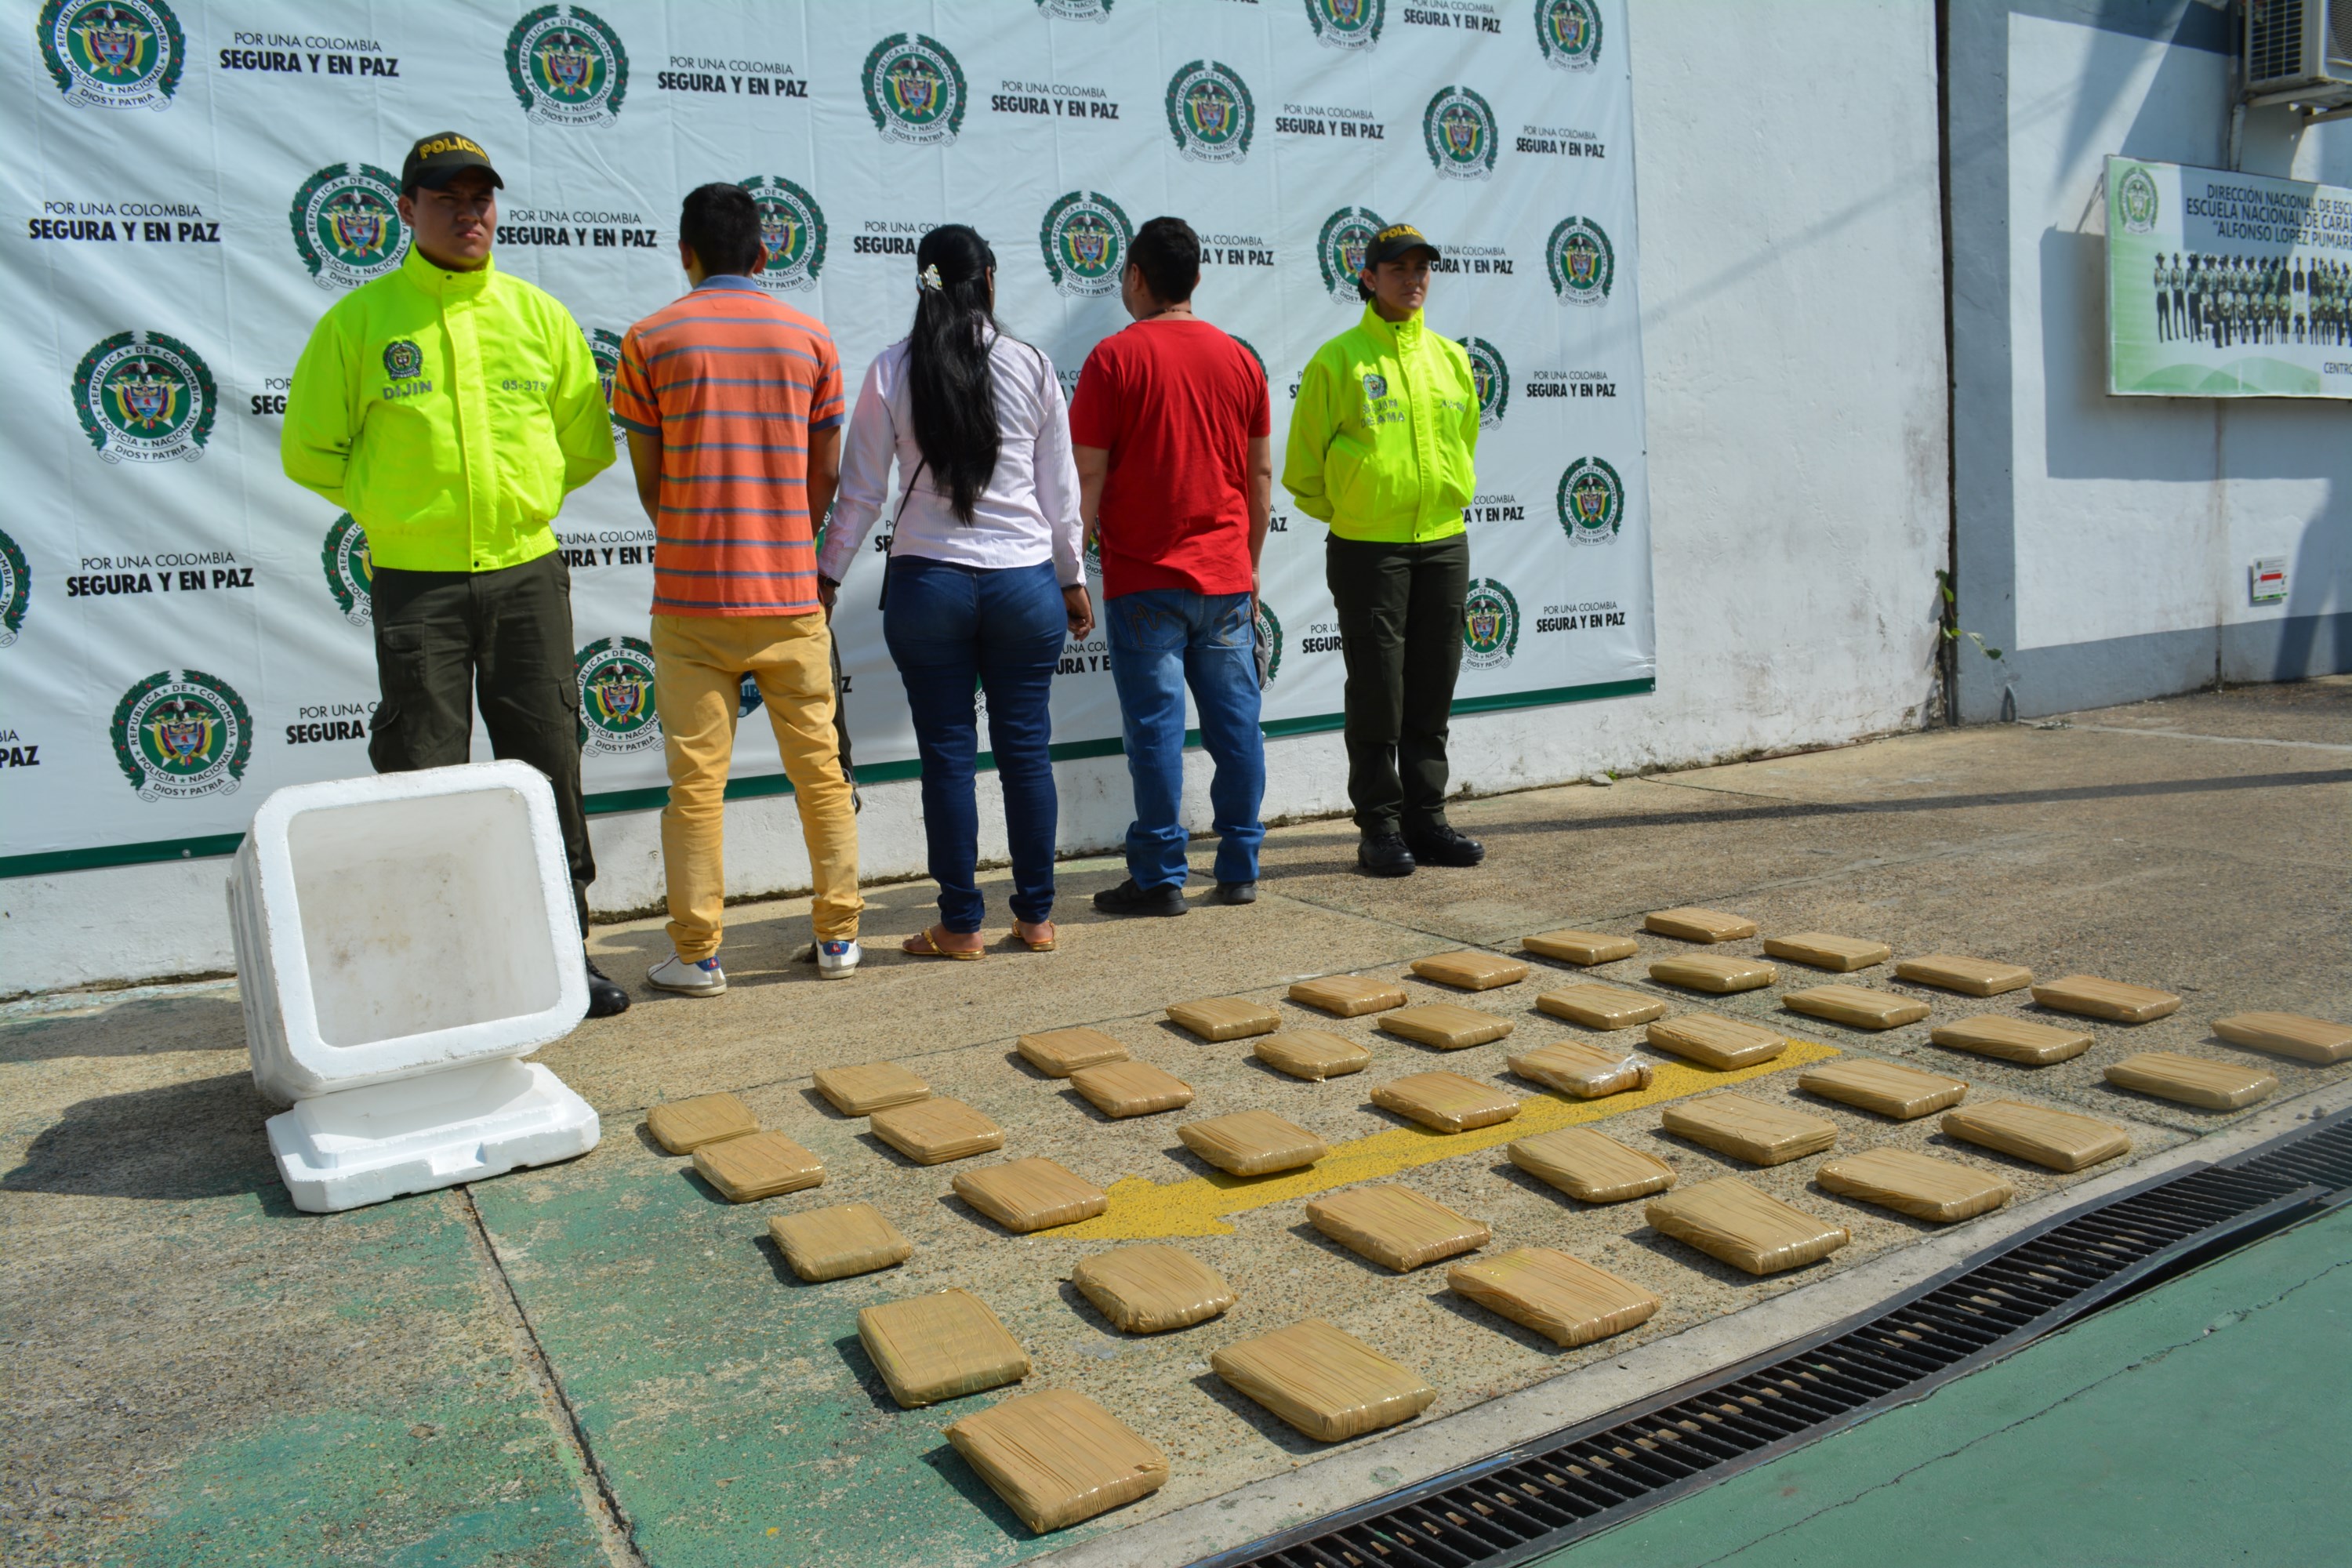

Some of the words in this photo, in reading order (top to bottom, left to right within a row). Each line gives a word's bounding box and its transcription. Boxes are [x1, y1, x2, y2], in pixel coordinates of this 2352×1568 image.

[1450, 1, 1495, 15] COLOMBIA
[1404, 8, 1450, 27] SEGURA
[1453, 13, 1461, 27] Y
[1465, 15, 1479, 30] EN
[1482, 16, 1501, 34] PAZ
[234, 32, 263, 45] POR
[267, 34, 302, 48] UNA
[305, 36, 382, 53] COLOMBIA
[583, 26, 615, 75] COLOMBIA
[220, 49, 302, 72] SEGURA
[307, 53, 321, 73] Y
[327, 55, 353, 74] EN
[359, 56, 399, 77] PAZ
[670, 56, 695, 68] POR
[698, 58, 727, 71] UNA
[729, 60, 793, 74] COLOMBIA
[658, 71, 727, 93] SEGURA
[731, 76, 742, 93] Y
[748, 77, 769, 96] EN
[775, 78, 808, 98] PAZ
[1002, 80, 1023, 93] POR
[1025, 82, 1051, 94] UNA
[1051, 84, 1107, 99] COLOMBIA
[80, 89, 107, 106] DIOS
[118, 93, 155, 107] PATRIA
[572, 86, 612, 112] NACIONAL
[992, 95, 1050, 114] SEGURA
[1054, 99, 1063, 115] Y
[1068, 100, 1086, 117] EN
[1091, 102, 1119, 119] PAZ
[572, 111, 604, 124] PATRIA
[1283, 103, 1302, 114] POR
[1304, 106, 1326, 116] UNA
[1327, 107, 1374, 120] COLOMBIA
[1276, 117, 1325, 135] SEGURA
[1329, 121, 1337, 136] Y
[1341, 122, 1356, 137] EN
[1360, 123, 1384, 140] PAZ
[1523, 125, 1537, 136] POR
[1538, 128, 1557, 136] UNA
[1559, 128, 1597, 140] COLOMBIA
[1516, 137, 1557, 154] SEGURA
[1560, 140, 1566, 154] Y
[1569, 142, 1581, 156] EN
[1584, 143, 1605, 158] PAZ
[2207, 184, 2263, 205] DIRECCIÓN
[2266, 191, 2316, 212] NACIONAL
[2319, 198, 2331, 212] DE
[45, 201, 76, 215] POR
[80, 202, 116, 216] UNA
[120, 203, 202, 217] COLOMBIA
[510, 209, 536, 222] POR
[539, 210, 570, 223] UNA
[572, 211, 642, 224] COLOMBIA
[2187, 198, 2238, 220] ESCUELA
[2241, 205, 2302, 227] NACIONAL
[2304, 212, 2318, 228] DE
[29, 219, 117, 241] SEGURA
[122, 222, 136, 241] Y
[143, 222, 171, 241] EN
[178, 223, 220, 242] PAZ
[865, 221, 887, 233] POR
[891, 223, 916, 234] UNA
[2275, 227, 2310, 245] LOPEZ
[496, 226, 571, 246] SEGURA
[575, 228, 586, 246] Y
[593, 228, 615, 246] EN
[622, 229, 657, 248] PAZ
[854, 236, 916, 255] SEGURA
[1214, 234, 1264, 247] COLOMBIA
[1214, 249, 1223, 264] Y
[1228, 249, 1244, 265] EN
[1248, 250, 1274, 266] PAZ
[1444, 245, 1461, 255] UNA
[1462, 246, 1506, 256] COLOMBIA
[1463, 259, 1470, 274] Y
[1474, 260, 1490, 274] EN
[1494, 260, 1513, 274] PAZ
[136, 346, 151, 354] DE
[163, 352, 201, 404] COLOMBIA
[1534, 371, 1549, 380] POR
[1550, 371, 1568, 380] UNA
[1569, 371, 1608, 380] COLOMBIA
[383, 379, 434, 401] DIJIN
[1526, 383, 1567, 397] SEGURA
[1570, 383, 1577, 397] Y
[1580, 383, 1593, 397] EN
[1596, 383, 1616, 397] PAZ
[1363, 398, 1398, 414] SIJIN
[151, 416, 198, 447] NACIONAL
[115, 445, 141, 459] DIOS
[152, 444, 188, 460] PATRIA
[1474, 495, 1516, 505] COLOMBIA
[1475, 508, 1483, 522] Y
[1486, 507, 1500, 522] EN
[1503, 506, 1524, 521] PAZ
[567, 533, 597, 544] UNA
[82, 557, 112, 571] POR
[116, 556, 152, 569] UNA
[155, 551, 236, 567] COLOMBIA
[601, 548, 613, 565] Y
[619, 546, 642, 564] EN
[67, 573, 153, 597] SEGURA
[157, 572, 172, 592] Y
[179, 570, 206, 590] EN
[212, 568, 254, 589] PAZ
[1544, 605, 1559, 615] POR
[1560, 604, 1577, 614] UNA
[1579, 601, 1617, 612] COLOMBIA
[1311, 623, 1328, 634] POR
[1537, 616, 1577, 633] SEGURA
[1580, 615, 1587, 629] Y
[1590, 614, 1602, 628] EN
[1606, 612, 1625, 626] PAZ
[1062, 642, 1085, 655] UNA
[1302, 636, 1342, 654] SEGUR
[1088, 655, 1098, 672] Y
[199, 688, 236, 738] COLOMBIA
[299, 706, 328, 719] POR
[332, 702, 365, 717] UNA
[286, 720, 366, 745] SEGURA
[189, 749, 234, 783] NACIONAL
[153, 783, 179, 796] DIOS
[190, 778, 225, 796] PATRIA
